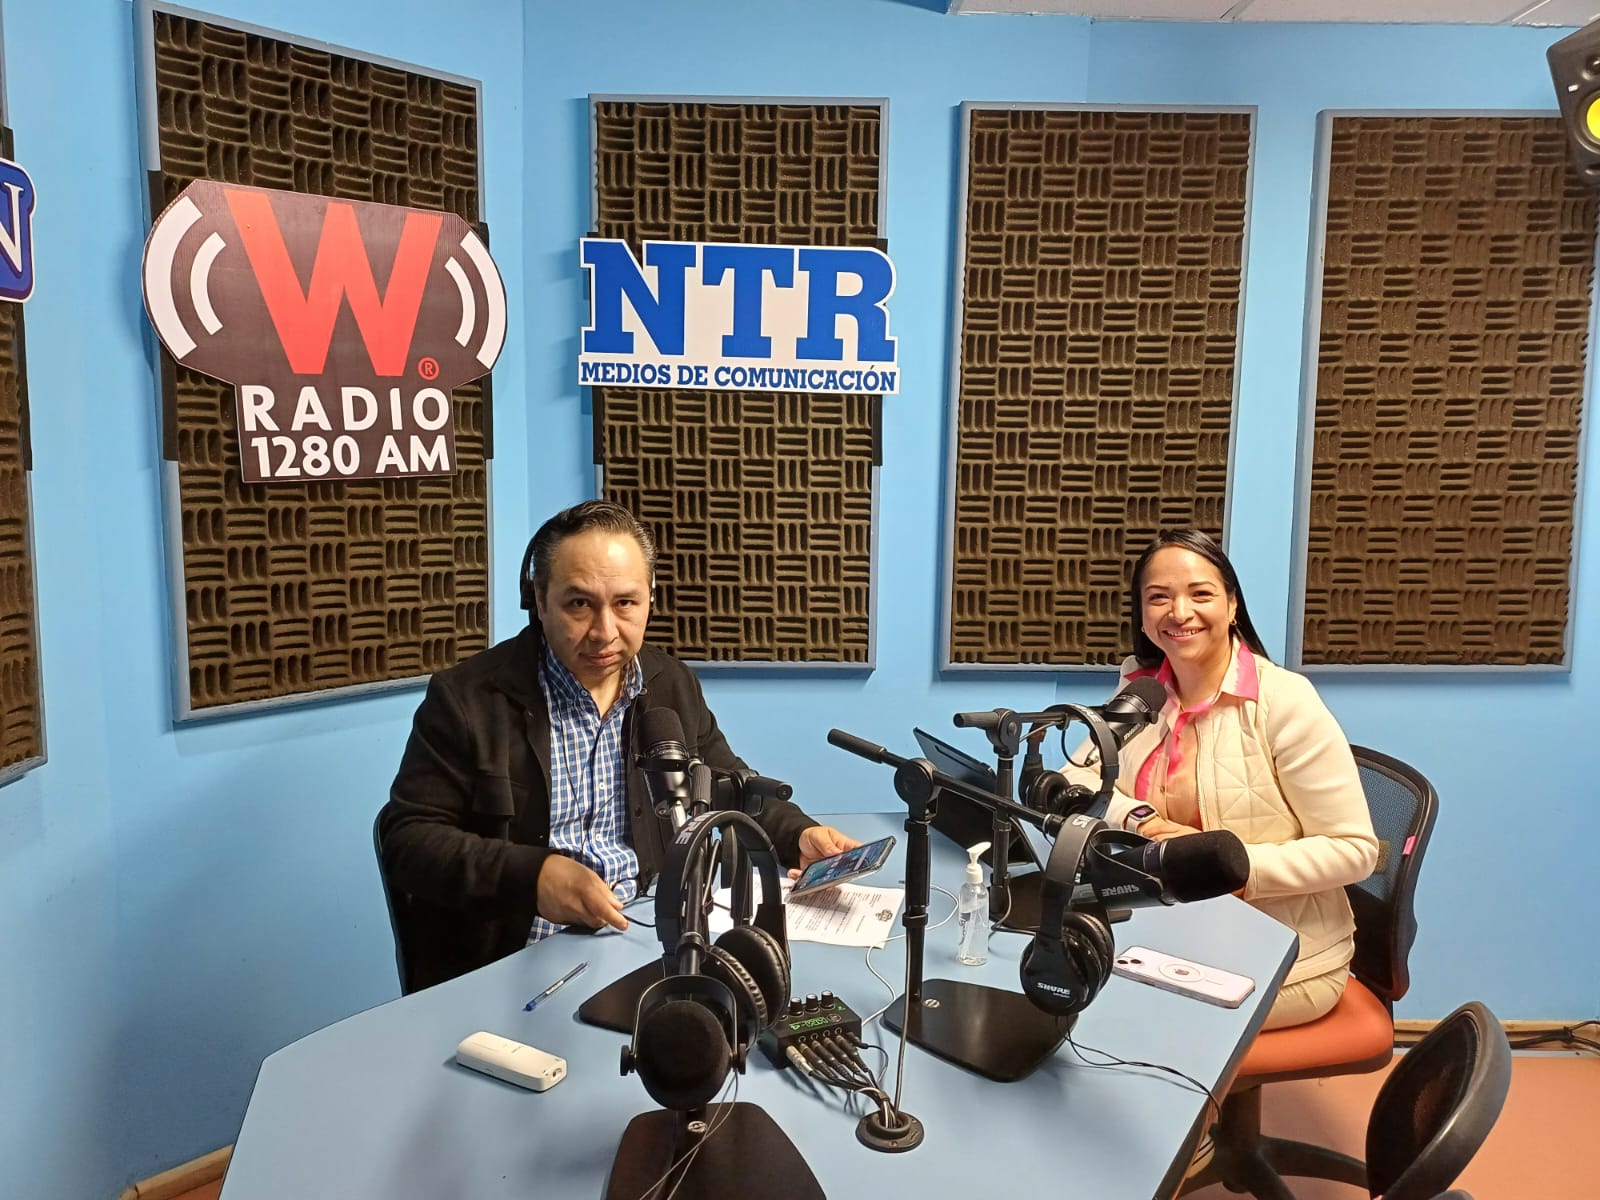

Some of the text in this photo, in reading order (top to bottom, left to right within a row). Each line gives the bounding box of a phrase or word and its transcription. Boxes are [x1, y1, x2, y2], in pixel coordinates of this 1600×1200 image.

[223, 188, 444, 377] W
[582, 240, 896, 362] NTR
[580, 362, 897, 392] MEDIOS DE COMUNICACIÓN
[241, 385, 450, 432] RADIO
[250, 434, 451, 478] 1280 AM
[1100, 884, 1140, 897] SHURE
[1037, 981, 1070, 995] SHURE
